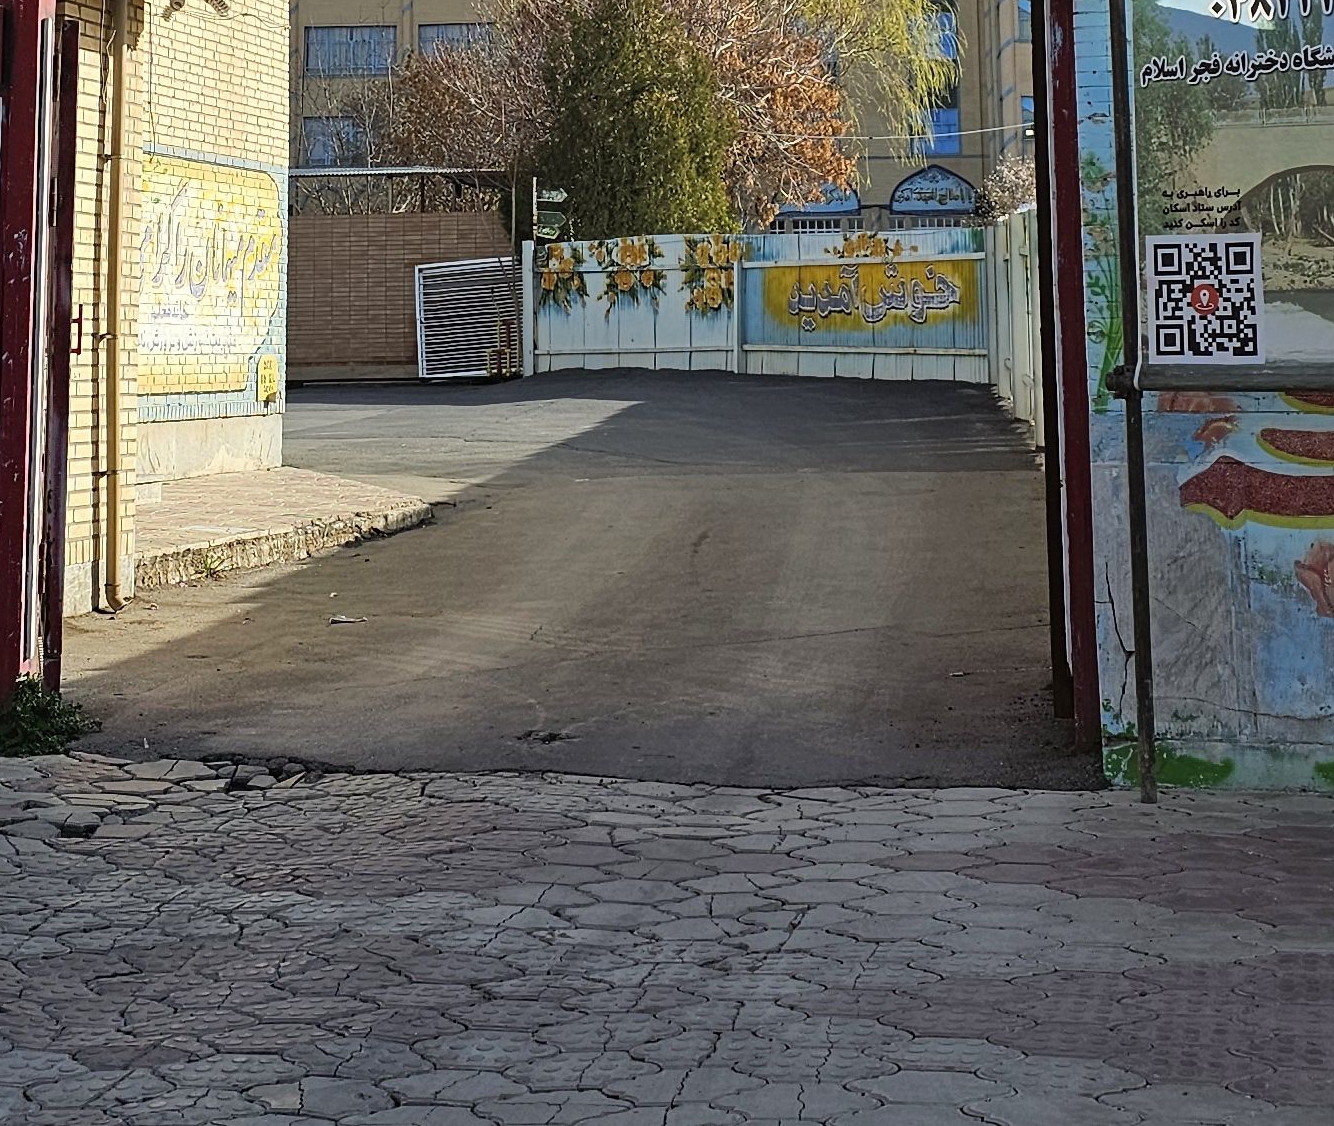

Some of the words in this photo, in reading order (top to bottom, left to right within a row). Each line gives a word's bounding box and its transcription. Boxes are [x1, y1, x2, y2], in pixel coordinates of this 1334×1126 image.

[1188, 51, 1221, 83] فجر
[1225, 47, 1290, 81] دخترانه
[1140, 56, 1185, 87] اسلام
[1162, 189, 1174, 200] به
[1177, 187, 1211, 199] راهبری
[1214, 185, 1241, 197] برای
[1162, 203, 1190, 215] اسکان
[1192, 202, 1214, 212] ستاد
[1216, 200, 1242, 213] آدرس
[1163, 218, 1183, 230] کنید
[1185, 217, 1217, 230] اسکن
[1219, 218, 1226, 228] را
[1229, 216, 1241, 227] کد
[788, 263, 860, 333] آمدید
[860, 263, 961, 324] خوش
